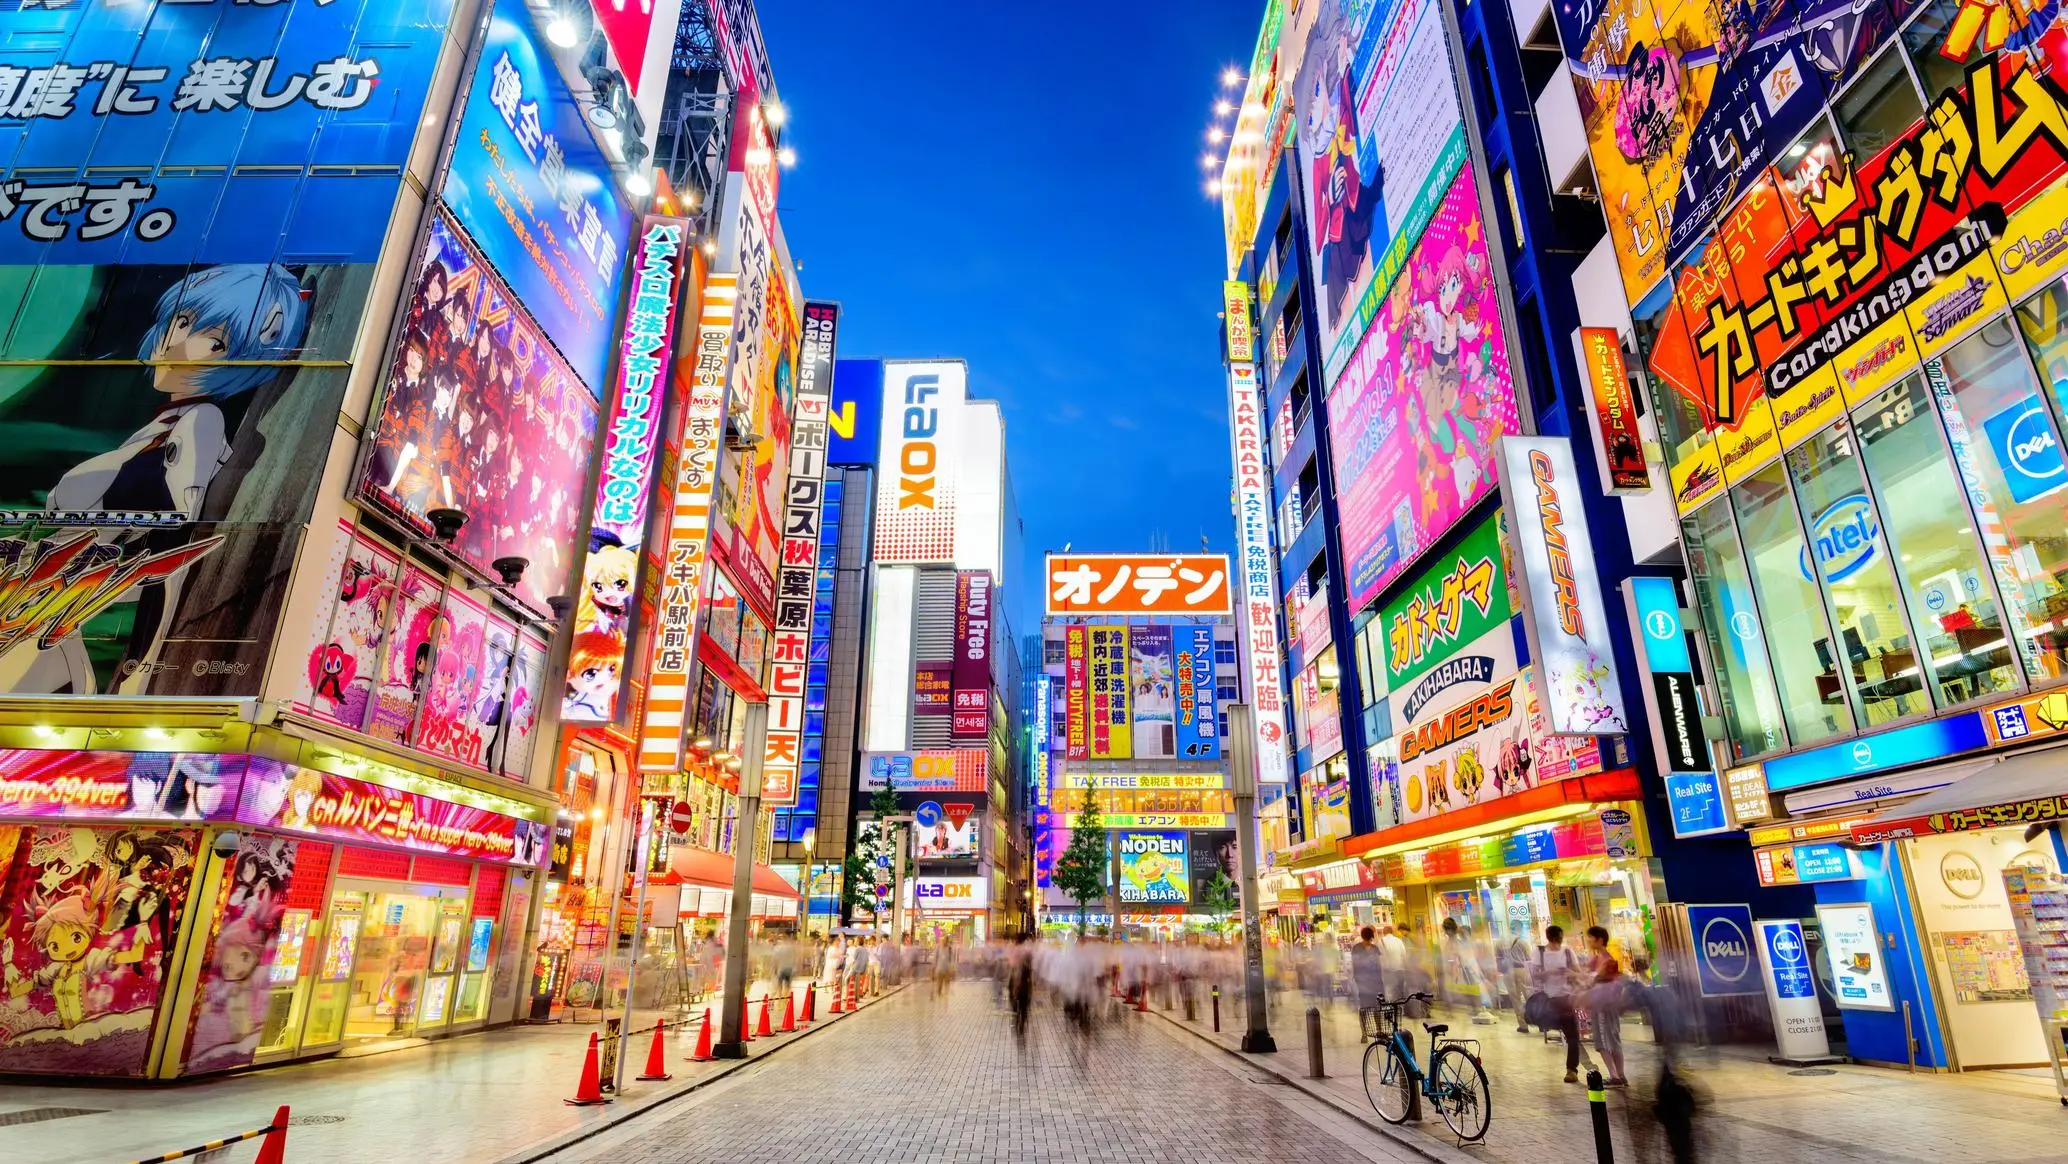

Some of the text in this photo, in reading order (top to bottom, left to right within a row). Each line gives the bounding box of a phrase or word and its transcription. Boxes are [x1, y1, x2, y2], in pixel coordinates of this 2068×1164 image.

[172, 58, 379, 112] 楽しむ
[1768, 67, 1796, 102] 金
[490, 52, 618, 288] 健全営業宣言
[1628, 102, 1763, 258] 七月十七日
[1678, 185, 1725, 237] ヴァンガード
[1699, 63, 2068, 418] カードキングダム
[1229, 298, 1248, 357] まんが喫茶
[1770, 218, 1992, 389] cardkingdom
[697, 331, 727, 387] 買取り
[800, 307, 820, 391] PARADISE
[817, 308, 834, 363] HOBBY
[602, 223, 681, 525] パチスロ魔法少女リリカルなのは
[1809, 385, 1836, 410] Spirits
[1235, 390, 1261, 490] TAKARADA
[2015, 430, 2058, 461] DEL
[1528, 449, 1587, 645] GAMERS
[1816, 506, 1870, 561] ntel
[1053, 558, 1224, 605] オノデン
[1247, 545, 1269, 597] 免税商店
[658, 542, 699, 673] アキバ駅前店
[958, 576, 969, 640] Flagship Store
[968, 576, 990, 660] Duty Free
[123, 659, 250, 677] ©カラー ©Bisty
[1411, 662, 1482, 711] AKIHABARA
[957, 693, 985, 706] 免税
[1038, 680, 1049, 743] Panasonic
[1401, 678, 1517, 764] GAMERS
[1668, 676, 1691, 758] ALIENWARE
[1186, 743, 1211, 756] 4F
[1072, 776, 1170, 787] TAX FREE 免税店
[1674, 781, 1713, 799] Real Site
[1855, 785, 1893, 800] Real Site
[950, 808, 967, 816] 止まれ
[1138, 816, 1176, 826] エアコン
[1179, 815, 1220, 826] 特売中!!
[1680, 806, 1691, 819] 2F
[1119, 889, 1186, 901] KIHABARA
[1946, 868, 1980, 882] DELL
[1123, 914, 1177, 923] オノデン
[1708, 940, 1744, 958] DELL
[1778, 941, 1801, 952] DELL
[1780, 972, 1808, 981] Real Site
[1786, 1017, 1806, 1025] OPEN
[1788, 1026, 1809, 1034] CLOSE
